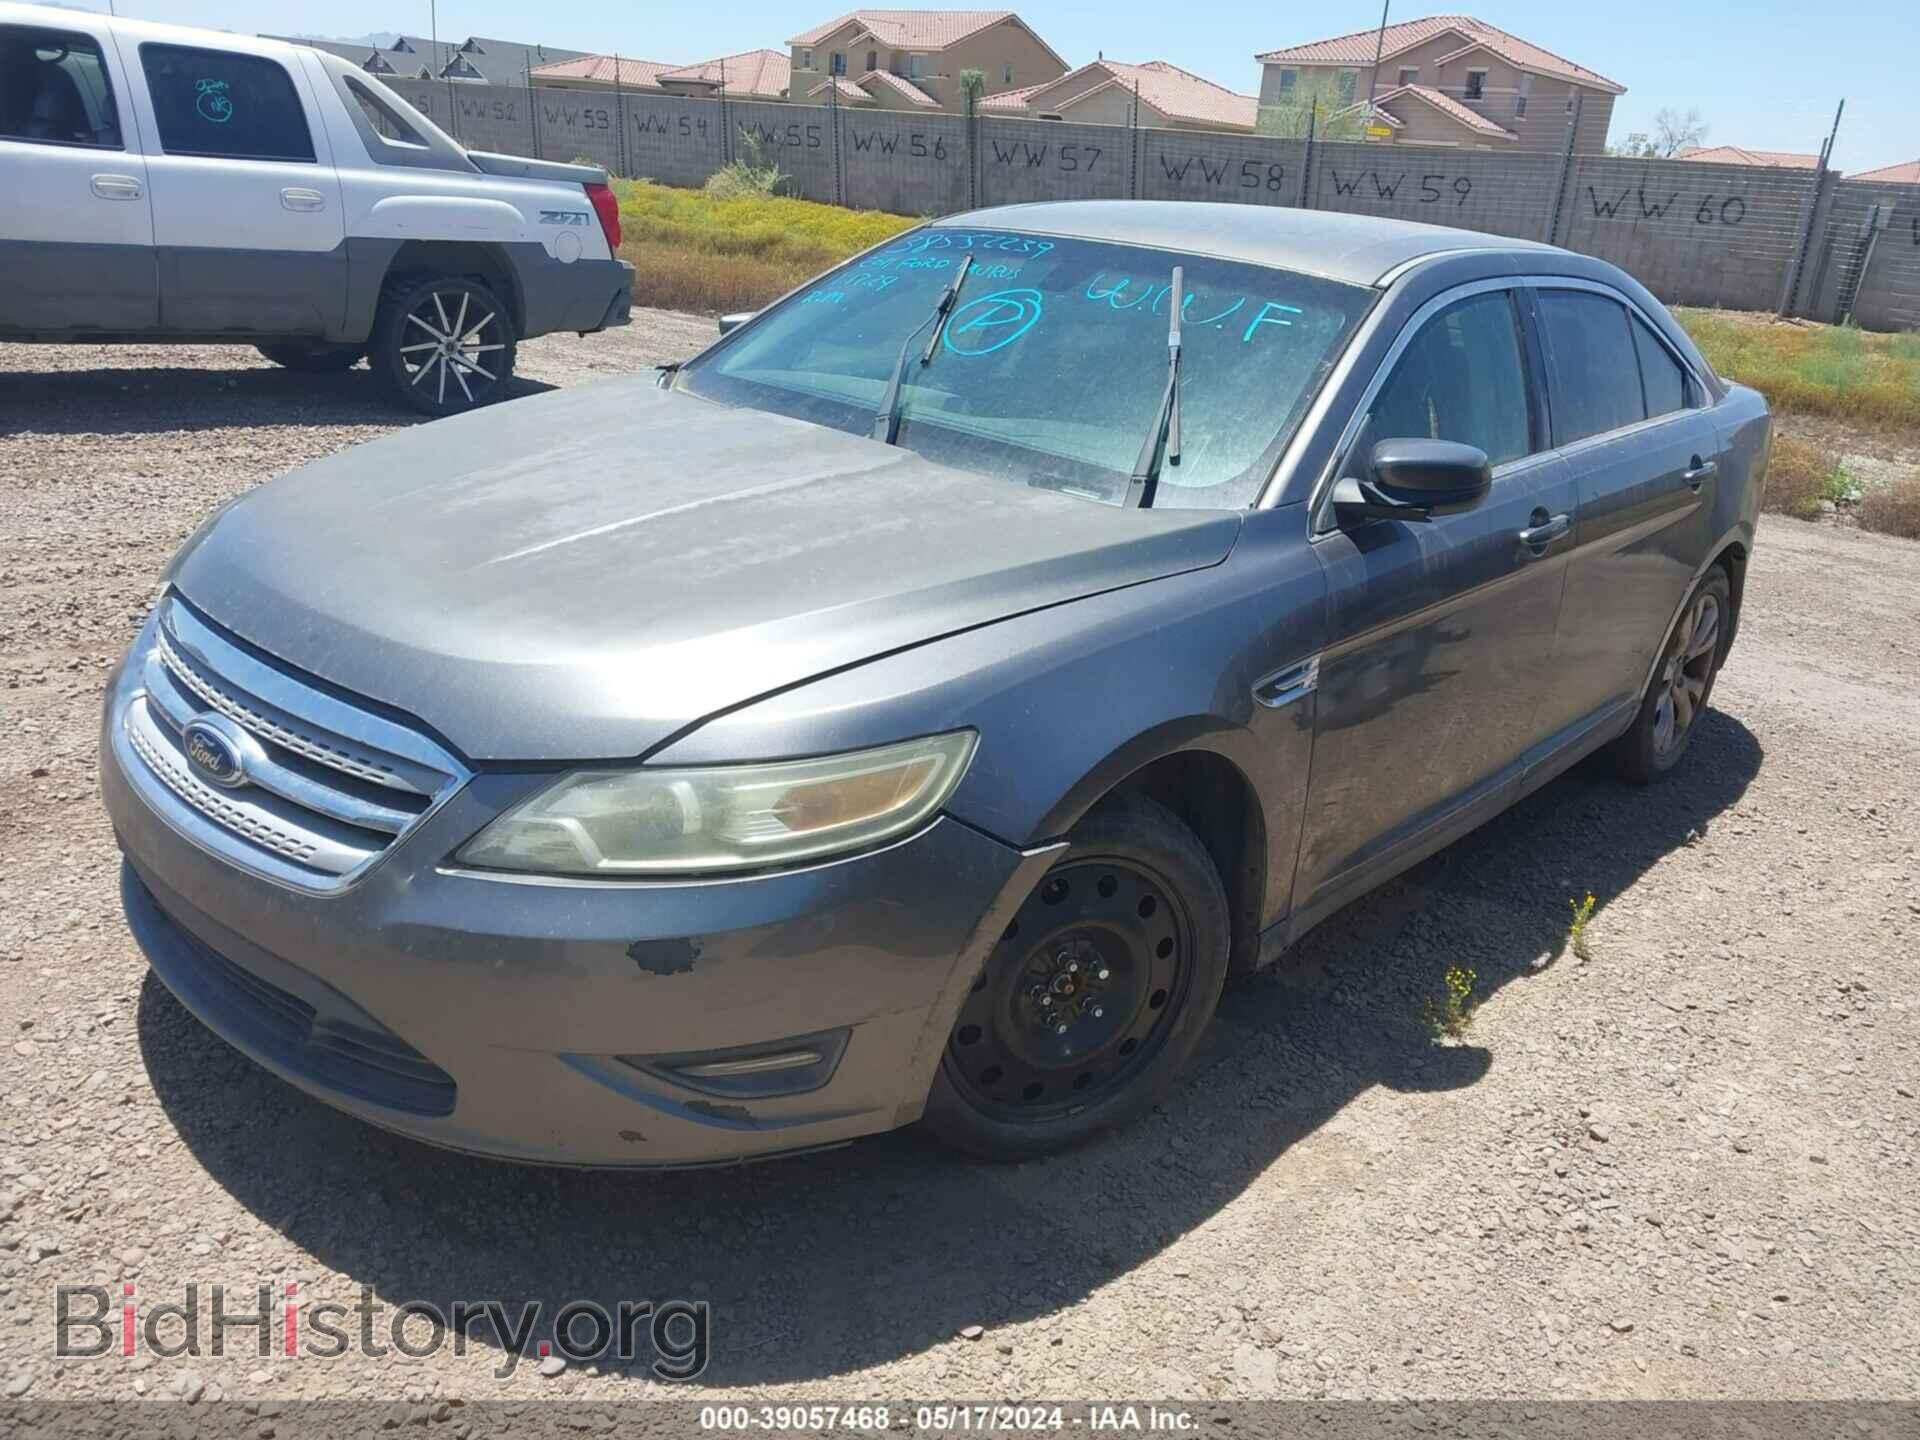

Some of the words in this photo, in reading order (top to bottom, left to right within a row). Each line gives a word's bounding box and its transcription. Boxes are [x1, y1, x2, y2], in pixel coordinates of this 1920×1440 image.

[544, 105, 579, 127] WW
[633, 113, 671, 134] WW
[679, 116, 709, 137] 54
[786, 124, 822, 148] 55
[851, 130, 900, 155] WW
[911, 134, 948, 161] 56
[991, 139, 1048, 169] WW
[1059, 144, 1102, 173] 57
[1160, 154, 1231, 186] WW
[1240, 160, 1285, 192] 58
[1330, 168, 1405, 200] WW
[1418, 175, 1473, 208] 59
[539, 210, 591, 226] Z71
[1588, 185, 1679, 219] WW
[1695, 194, 1746, 225] 60
[898, 256, 950, 269] FORD
[191, 732, 223, 771] Ford
